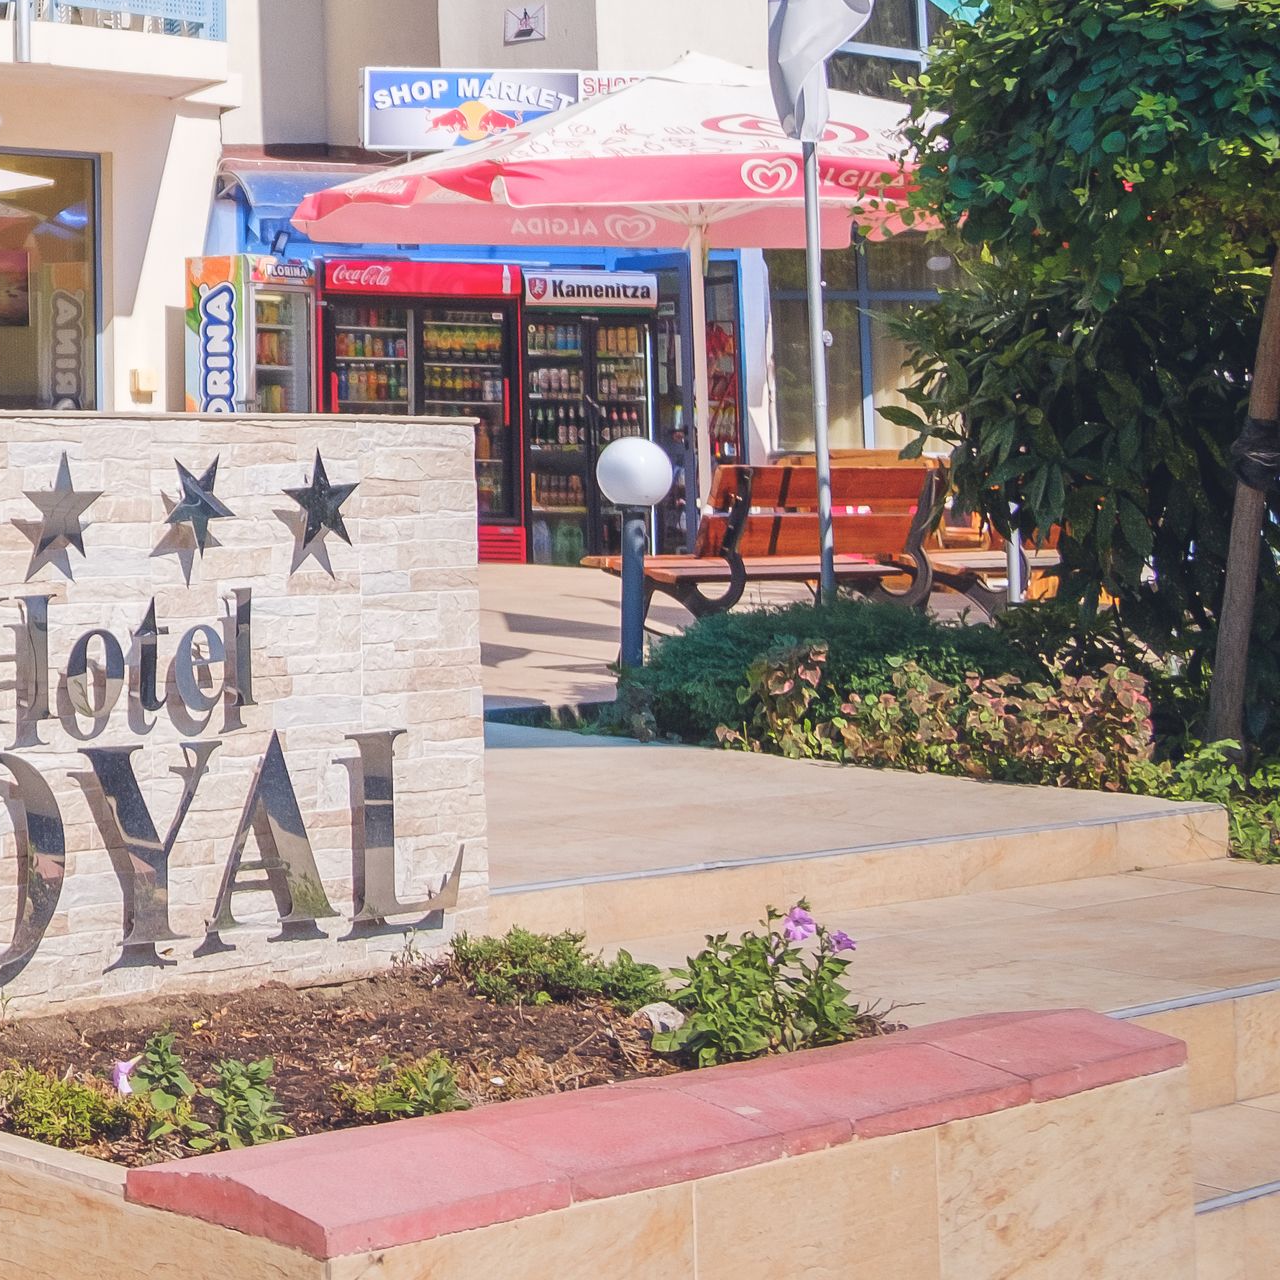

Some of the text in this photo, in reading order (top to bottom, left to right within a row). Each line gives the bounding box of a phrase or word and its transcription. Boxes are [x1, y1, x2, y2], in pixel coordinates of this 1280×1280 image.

[373, 78, 576, 111] SHOP MARKET
[266, 264, 308, 278] FLORINA
[551, 279, 652, 300] Kamenitza
